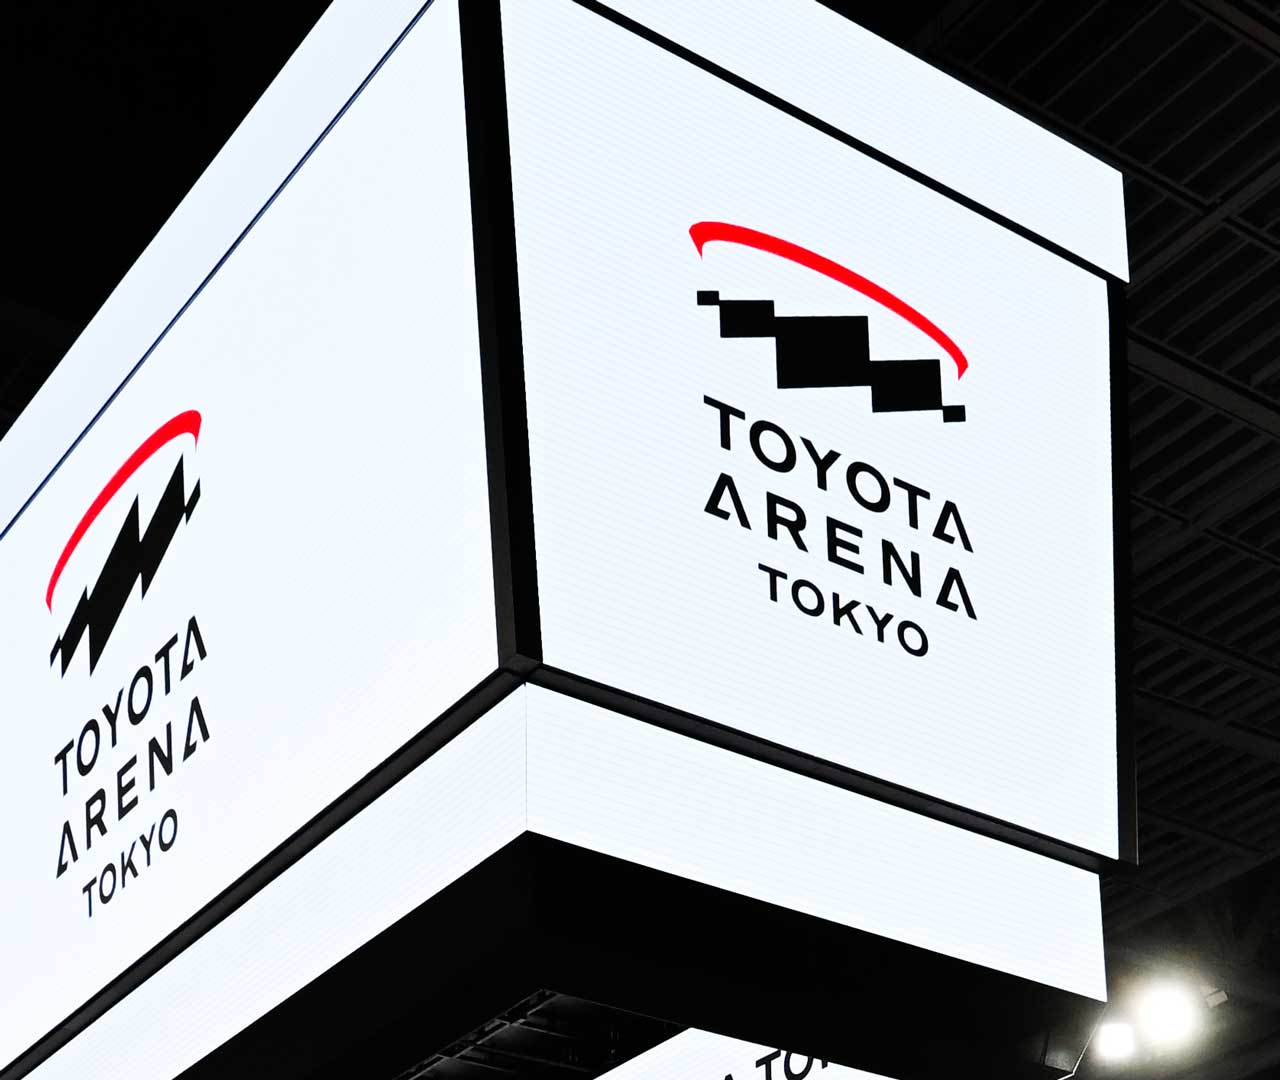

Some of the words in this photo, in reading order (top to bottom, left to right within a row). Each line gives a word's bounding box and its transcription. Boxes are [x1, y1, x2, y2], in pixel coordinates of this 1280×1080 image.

[703, 394, 974, 554] TOYOTA
[703, 472, 978, 621] ARENA
[757, 562, 929, 658] TOKYO
[54, 615, 208, 796] TOYOTA
[56, 695, 210, 879] ARENA
[82, 808, 178, 918] TOKYO
